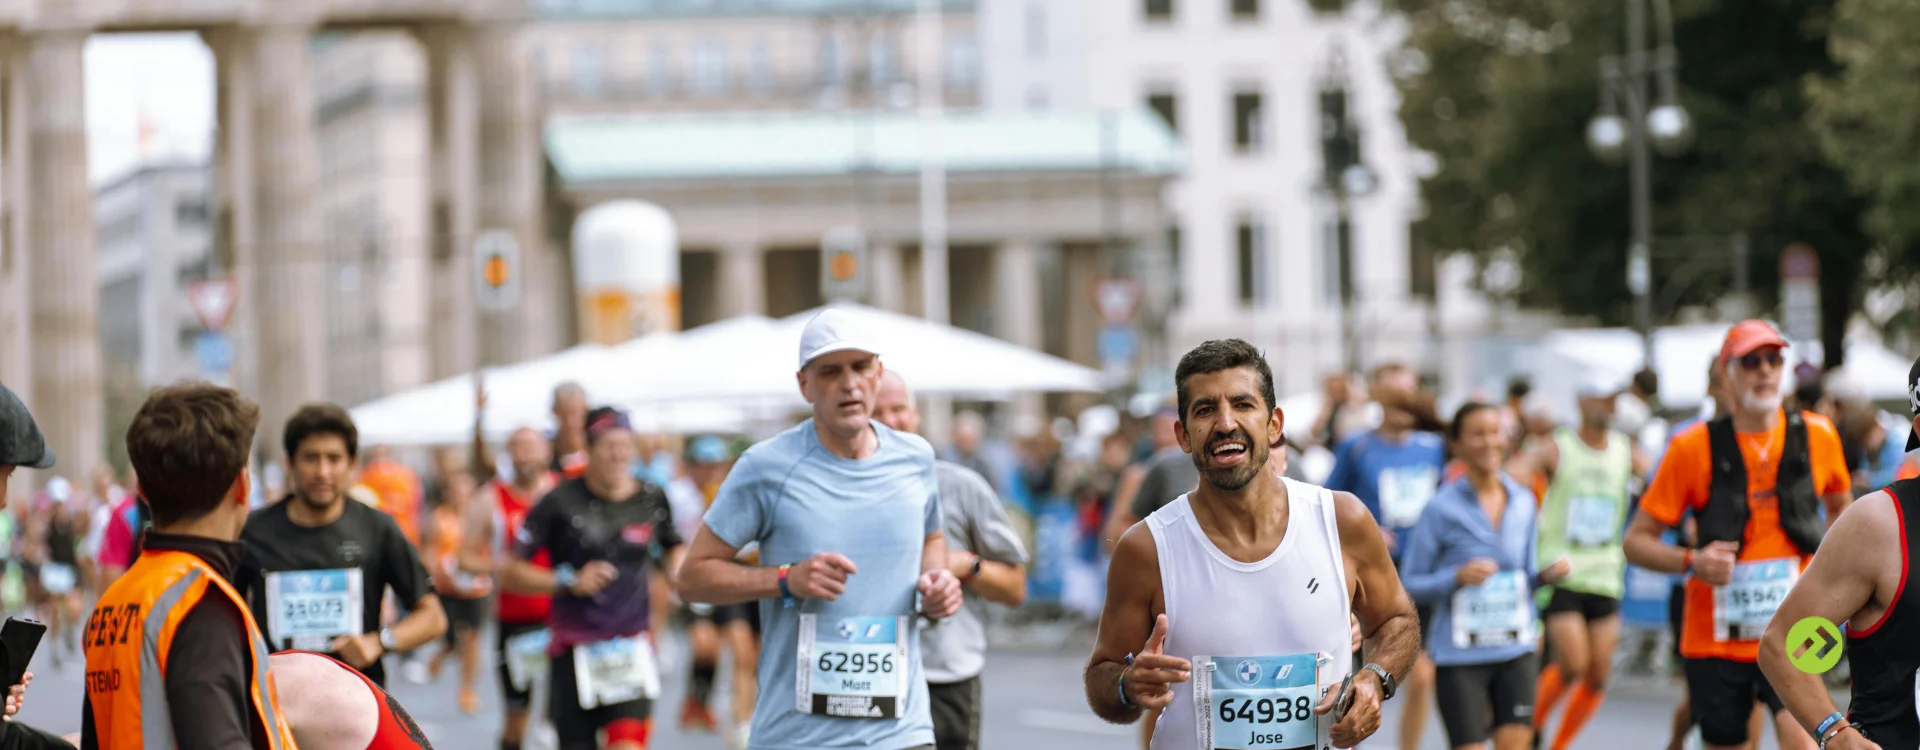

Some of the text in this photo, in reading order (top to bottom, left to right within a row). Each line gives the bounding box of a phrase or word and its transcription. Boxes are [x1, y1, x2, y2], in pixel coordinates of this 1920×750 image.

[818, 652, 893, 673] 62956
[841, 680, 871, 691] Matt
[1219, 696, 1311, 724] 64938
[1248, 731, 1283, 746] Jose
